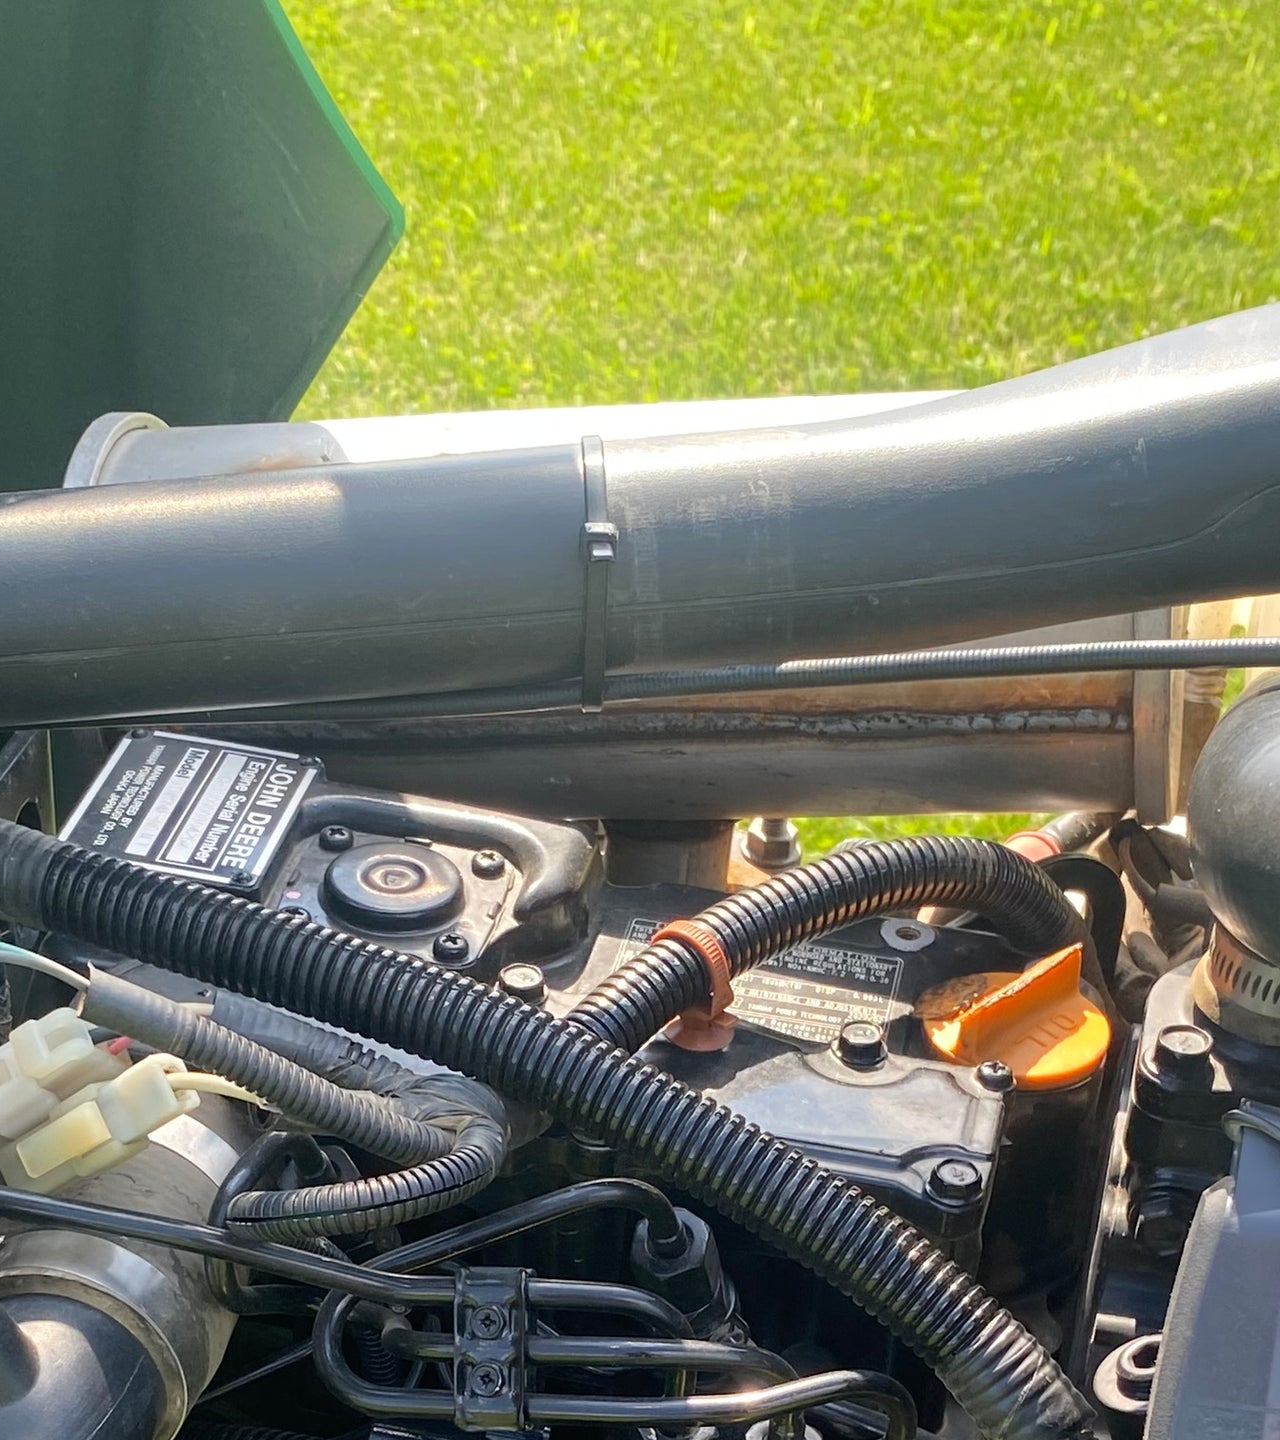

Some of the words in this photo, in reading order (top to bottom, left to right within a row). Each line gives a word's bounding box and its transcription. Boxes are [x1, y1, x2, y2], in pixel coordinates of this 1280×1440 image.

[113, 769, 137, 791] OSAKA
[174, 750, 206, 779] Model
[234, 761, 266, 793] Engine
[99, 792, 121, 815] JAPAN
[125, 764, 166, 817] MANUFACTURED
[255, 763, 297, 816] JOHN
[118, 817, 133, 828] BY
[218, 792, 240, 827] Serial
[192, 820, 226, 865] Number
[219, 807, 265, 870] DEERE
[794, 944, 878, 963] NFORMATION
